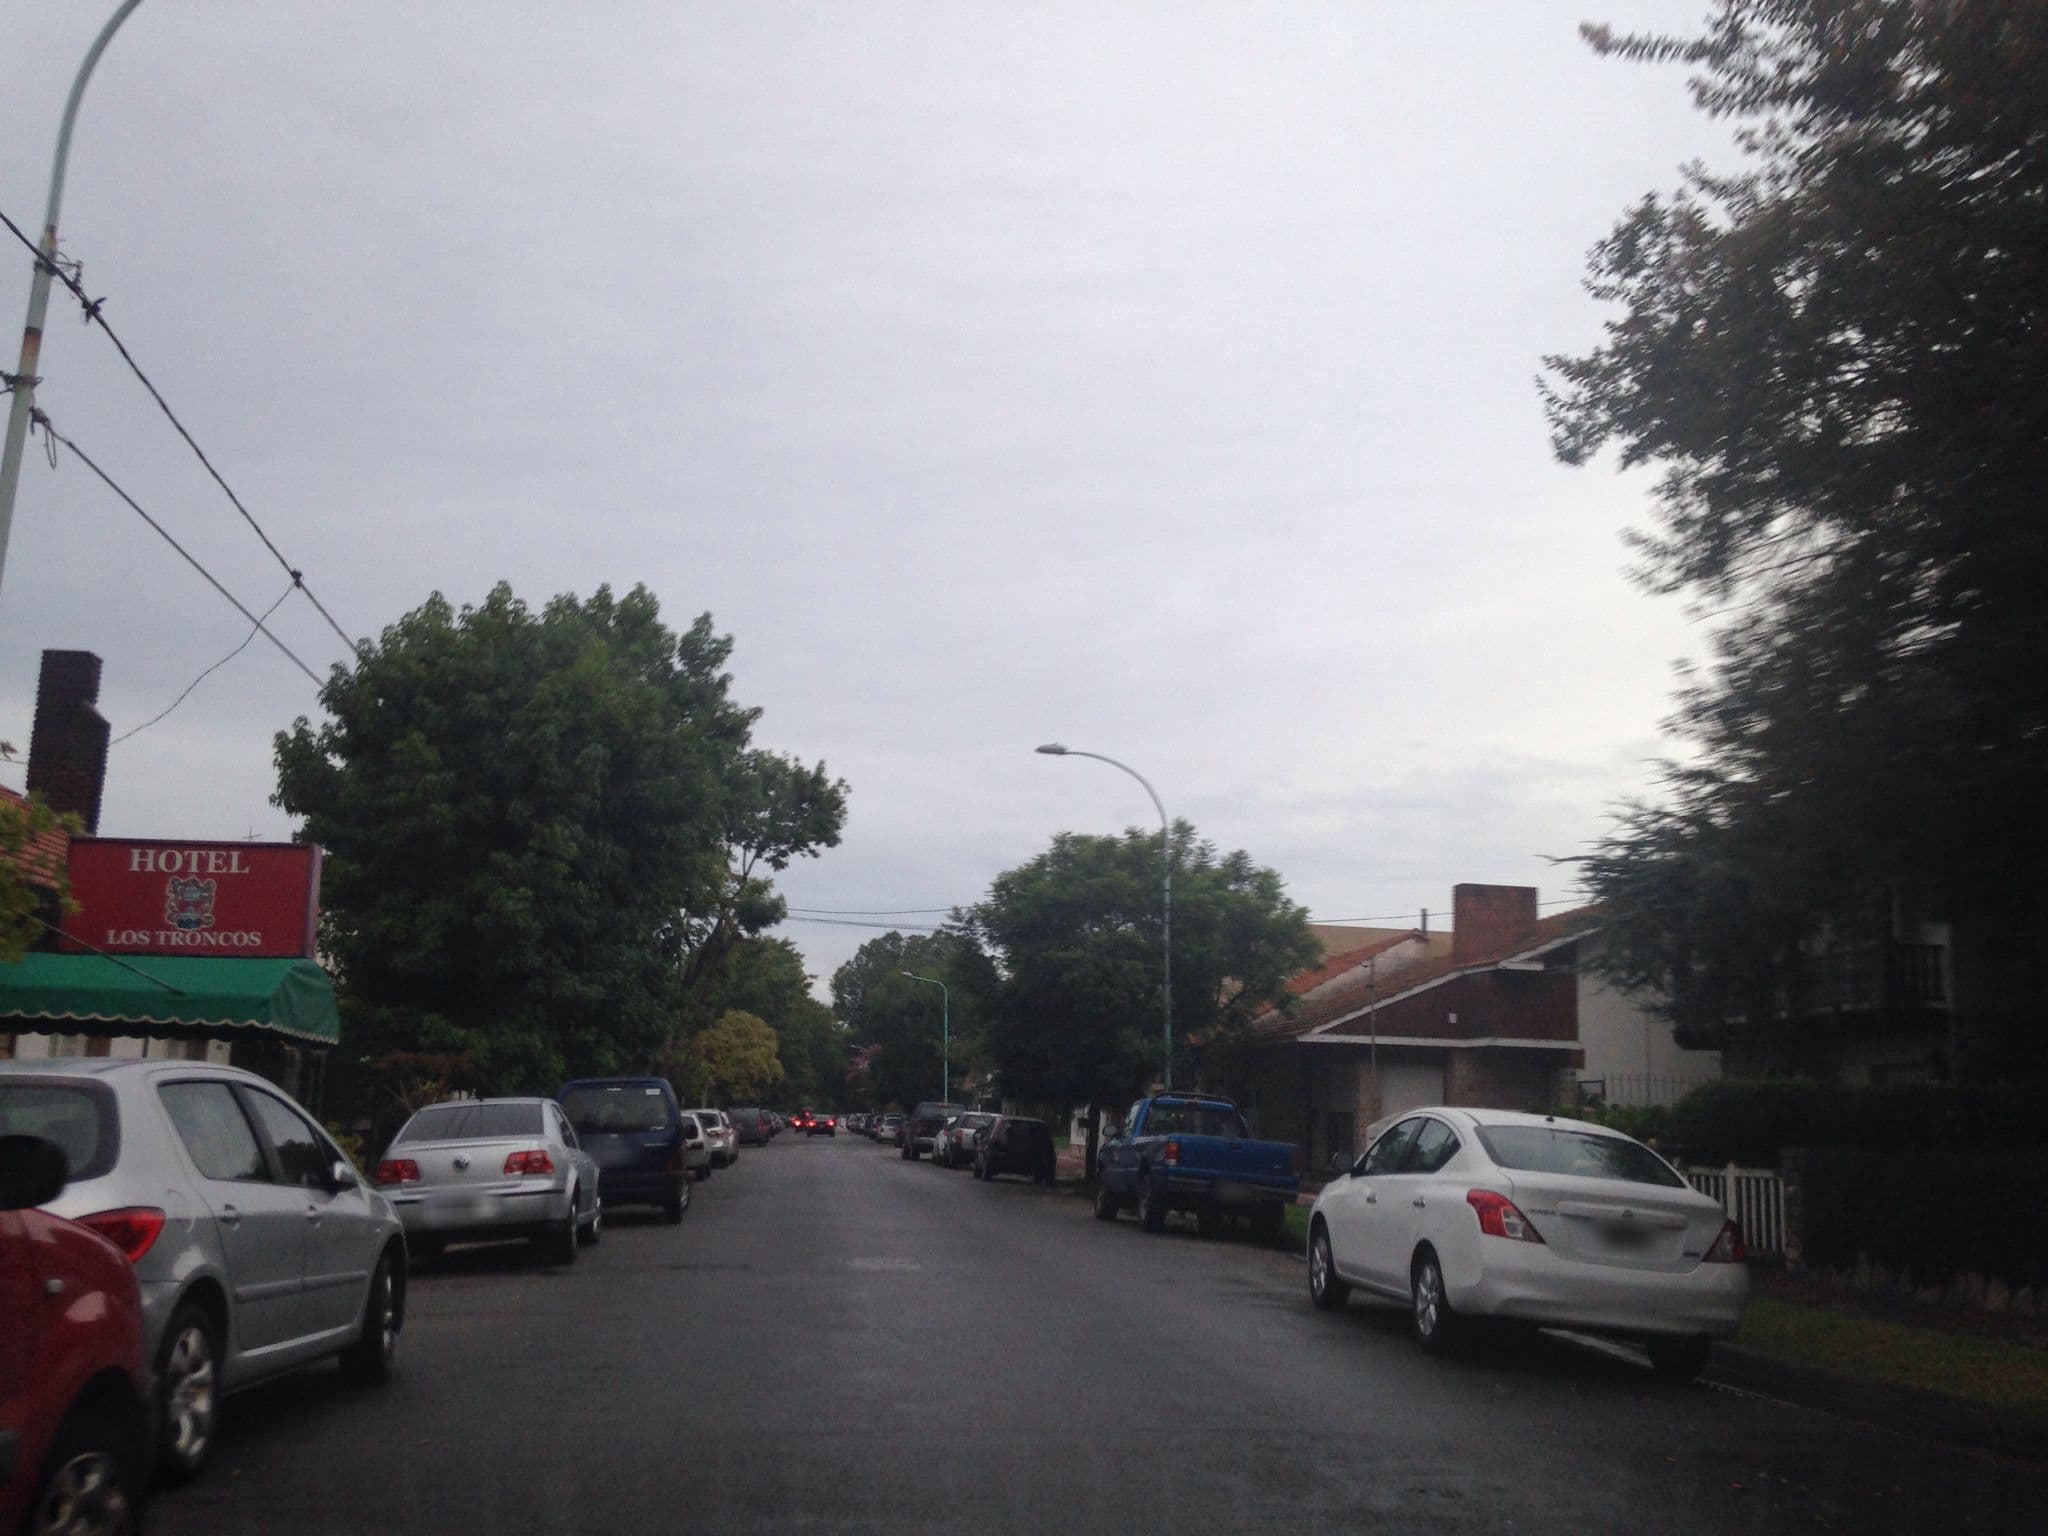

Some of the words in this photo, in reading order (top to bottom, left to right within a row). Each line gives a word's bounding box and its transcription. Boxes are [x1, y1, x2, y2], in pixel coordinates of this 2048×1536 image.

[129, 848, 250, 874] HOTEL
[107, 929, 150, 945] LOS
[155, 930, 262, 947] TRONCOS
